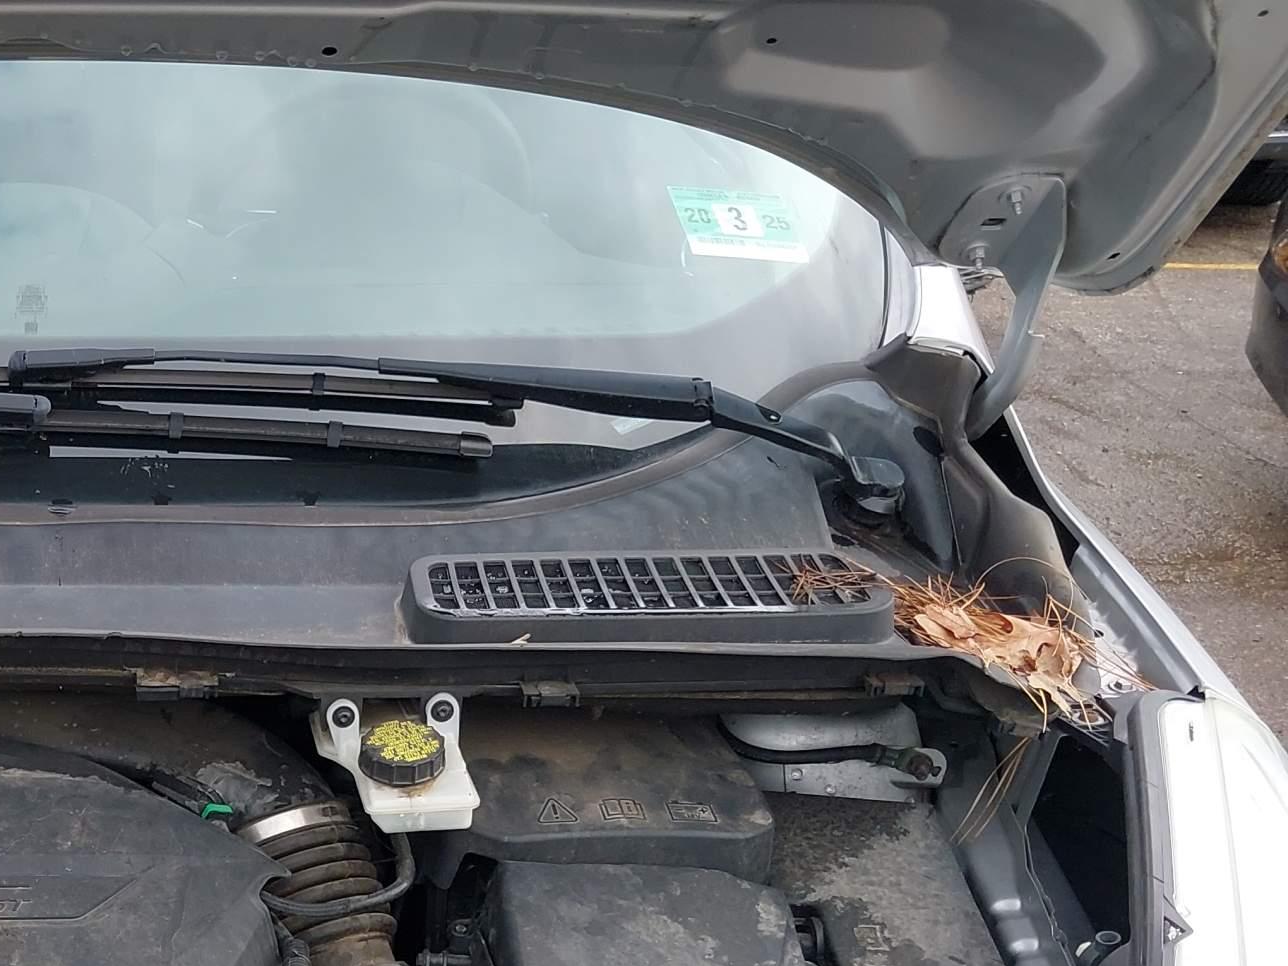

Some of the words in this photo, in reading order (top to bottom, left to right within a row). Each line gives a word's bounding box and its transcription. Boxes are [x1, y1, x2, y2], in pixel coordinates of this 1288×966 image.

[684, 208, 712, 224] 20
[728, 207, 748, 231] 3
[762, 215, 791, 230] 25
